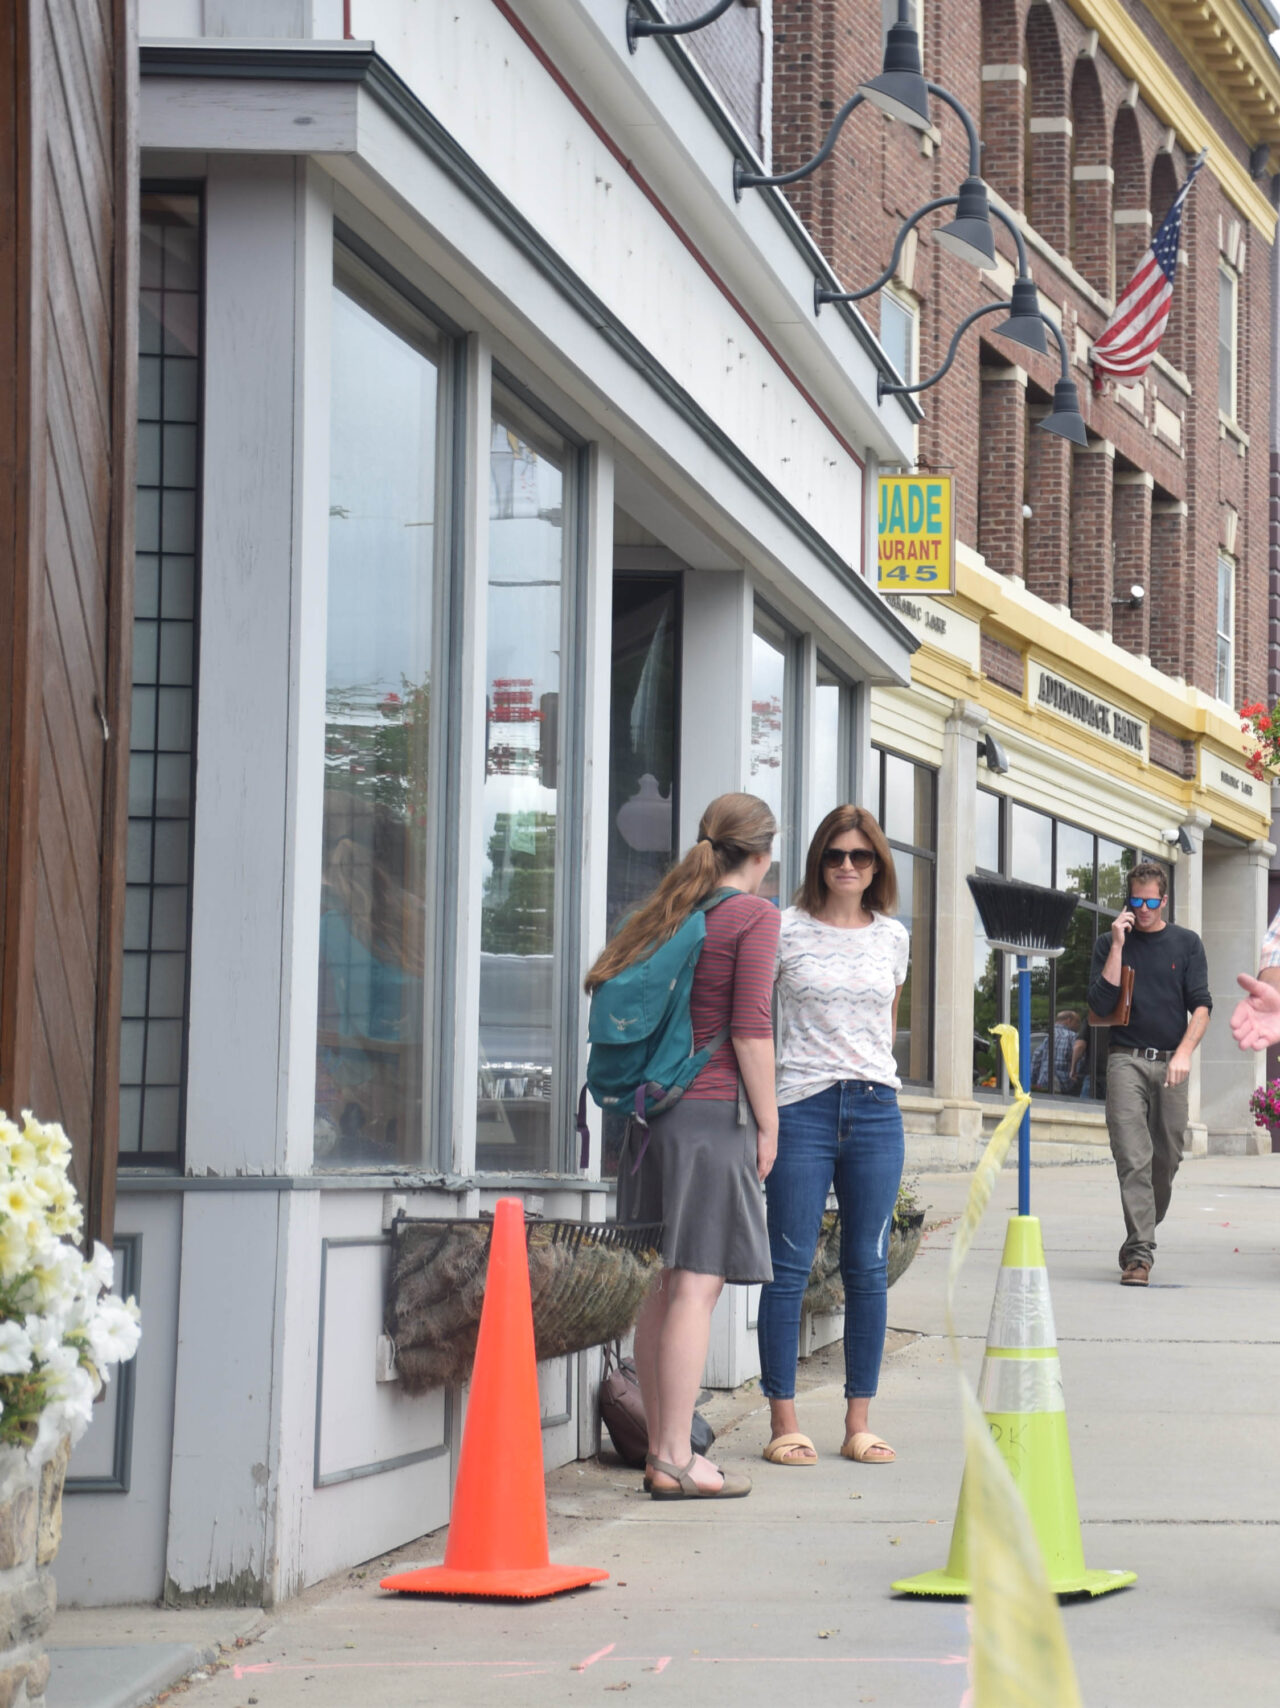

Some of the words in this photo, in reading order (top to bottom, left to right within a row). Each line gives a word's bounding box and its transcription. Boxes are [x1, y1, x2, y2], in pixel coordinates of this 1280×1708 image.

[878, 484, 942, 534] JADE
[1038, 672, 1111, 735] ADIRONDACK
[1113, 711, 1143, 751] BANK
